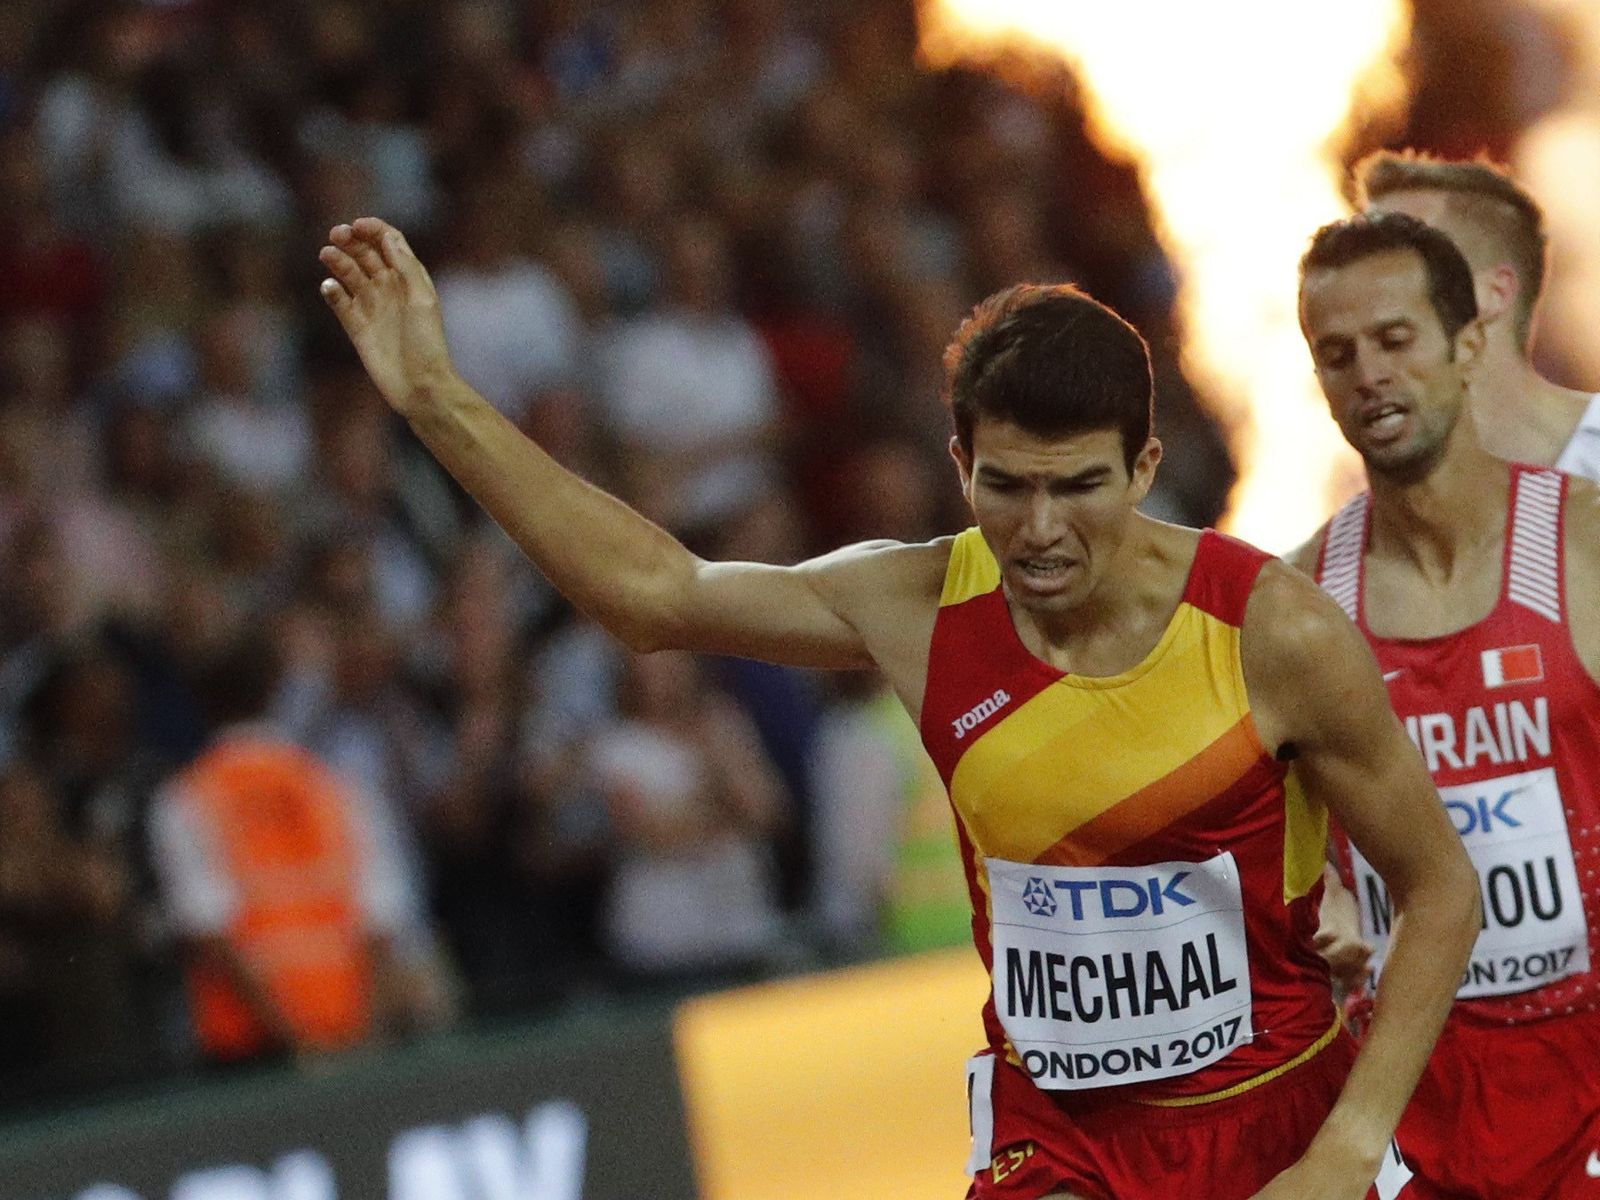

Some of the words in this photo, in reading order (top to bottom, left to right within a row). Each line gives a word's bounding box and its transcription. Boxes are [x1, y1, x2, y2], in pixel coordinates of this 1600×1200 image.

[1405, 696, 1552, 772] RAIN
[1443, 786, 1531, 836] DK
[1054, 871, 1197, 921] TDK
[1006, 932, 1237, 1024] MECHAAL
[1502, 946, 1576, 983] 2017
[1021, 1043, 1162, 1080] ONDON
[1167, 1014, 1244, 1067] 2017
[991, 1143, 1035, 1184] ES
